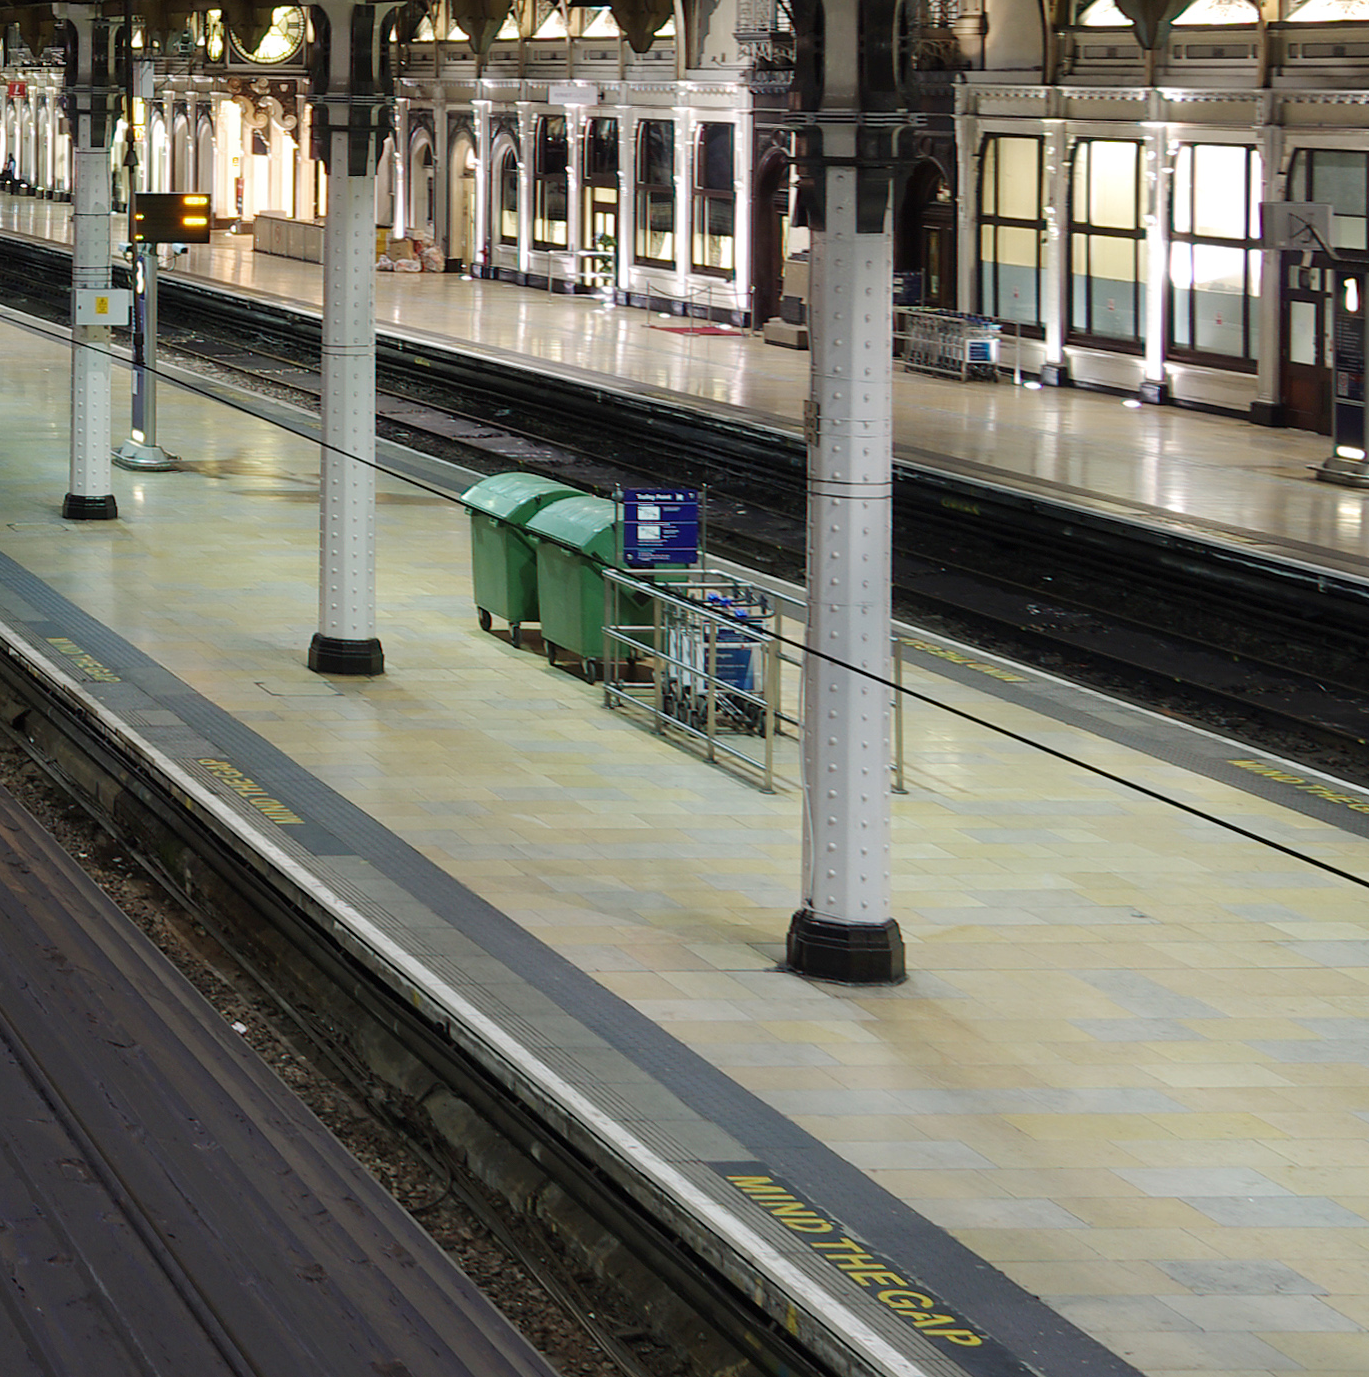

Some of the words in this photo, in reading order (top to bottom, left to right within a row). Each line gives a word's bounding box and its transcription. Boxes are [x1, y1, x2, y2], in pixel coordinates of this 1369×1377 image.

[1344, 277, 1359, 312] 1
[198, 758, 244, 779] GAP
[221, 777, 269, 798] THE
[248, 797, 306, 825] MIND
[725, 1175, 835, 1234] MIND
[810, 1236, 909, 1287] THE
[877, 1289, 983, 1347] GAP
